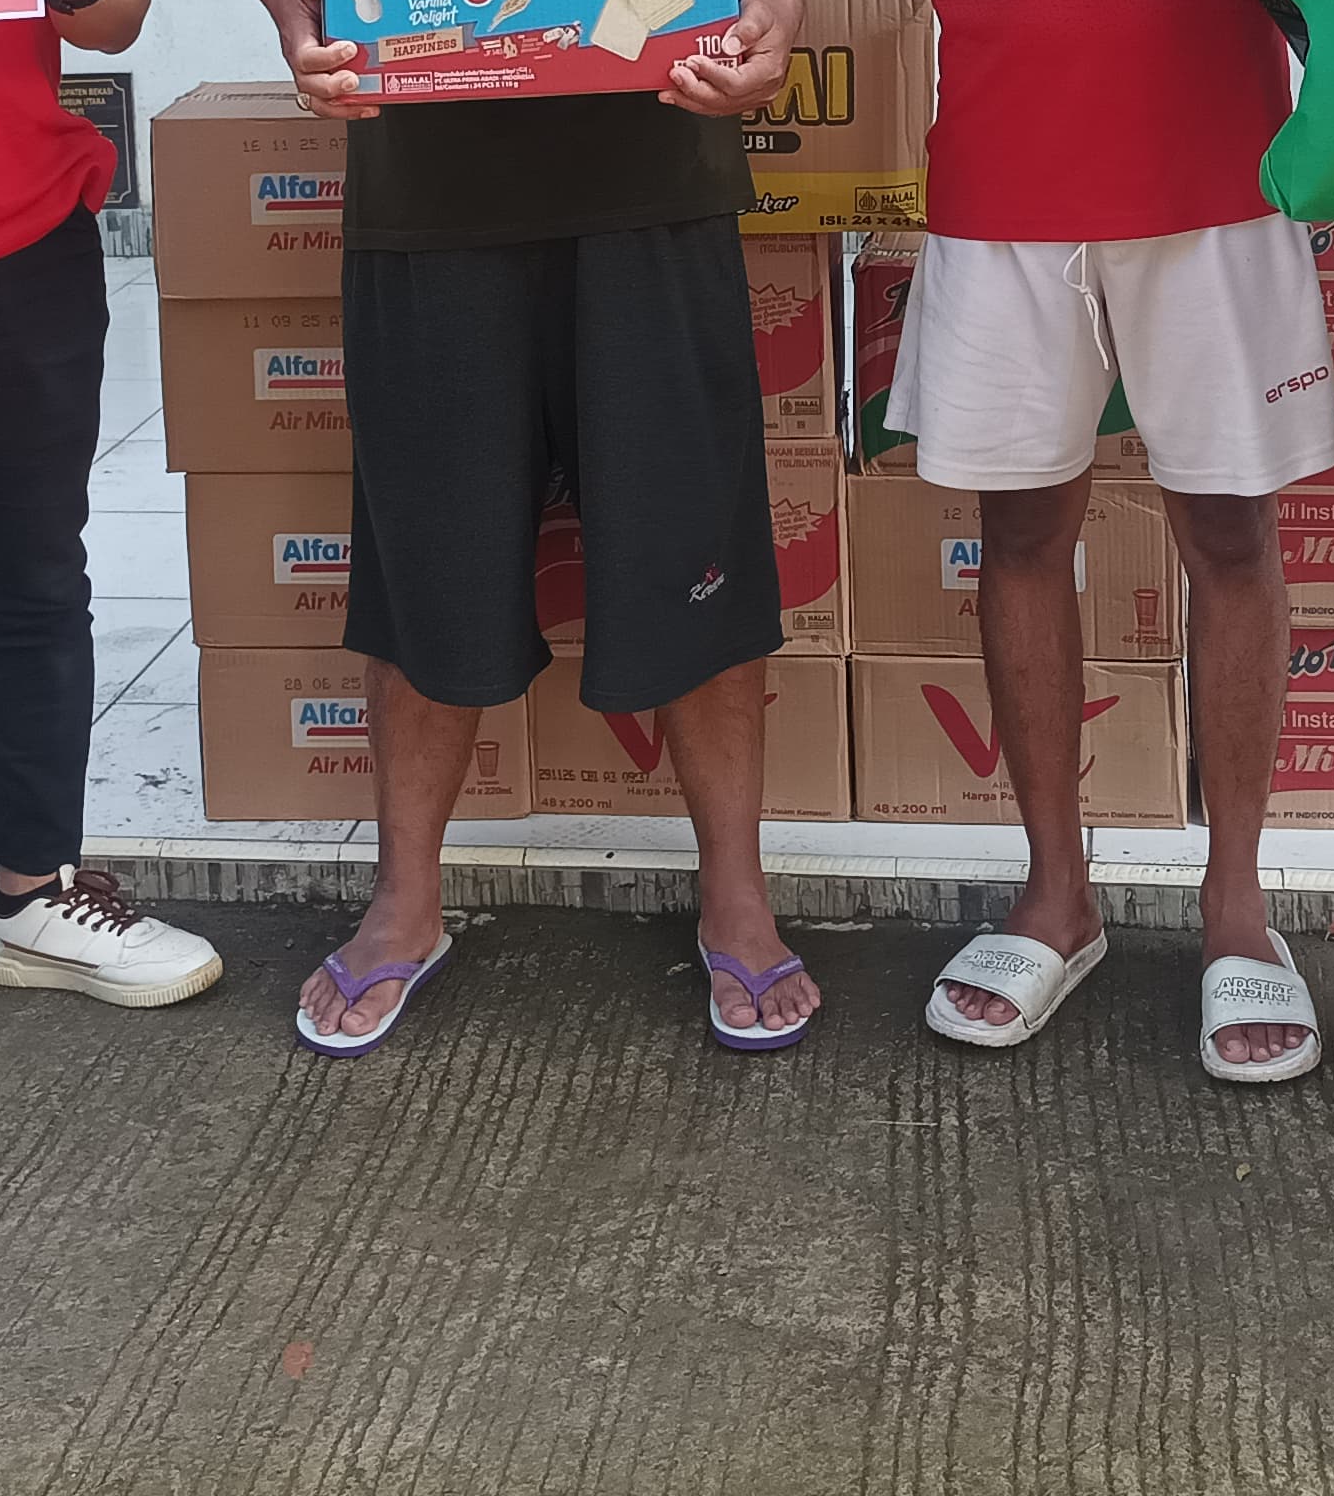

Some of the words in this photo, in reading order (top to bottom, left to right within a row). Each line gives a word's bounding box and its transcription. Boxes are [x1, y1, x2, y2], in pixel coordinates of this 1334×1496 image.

[409, 6, 459, 26] Delight
[392, 38, 458, 58] HAPPINESS
[694, 35, 721, 56] 110
[401, 76, 430, 84] HALAL
[88, 87, 114, 96] BEKASI
[273, 139, 289, 152] 11
[299, 137, 320, 151] 25
[257, 174, 344, 200] Alfam
[880, 191, 915, 204] HALAL
[819, 215, 847, 226] ISI:
[851, 215, 872, 225] 24
[876, 216, 887, 225] x
[267, 232, 299, 250] Air
[302, 231, 343, 250] Min
[243, 315, 260, 329] 11
[300, 314, 321, 328] 25
[267, 355, 345, 376] Alfam
[1265, 366, 1330, 404] erspo
[269, 411, 302, 430] Air
[943, 507, 962, 521] 12
[949, 541, 980, 565] Al
[294, 591, 326, 610] Air
[330, 591, 348, 610] M
[283, 677, 303, 691] 28
[341, 677, 362, 691] 25
[307, 756, 339, 775] Air
[464, 786, 476, 795] 48
[627, 787, 661, 797] Harga
[962, 790, 997, 803] Harga
[540, 798, 557, 808] 48
[559, 799, 566, 808] x
[569, 798, 594, 809] 200
[597, 799, 612, 809] ml
[873, 804, 890, 815] 48
[892, 805, 900, 815] x
[901, 804, 928, 815] 200
[931, 804, 947, 815] ml
[1283, 811, 1293, 819] PT
